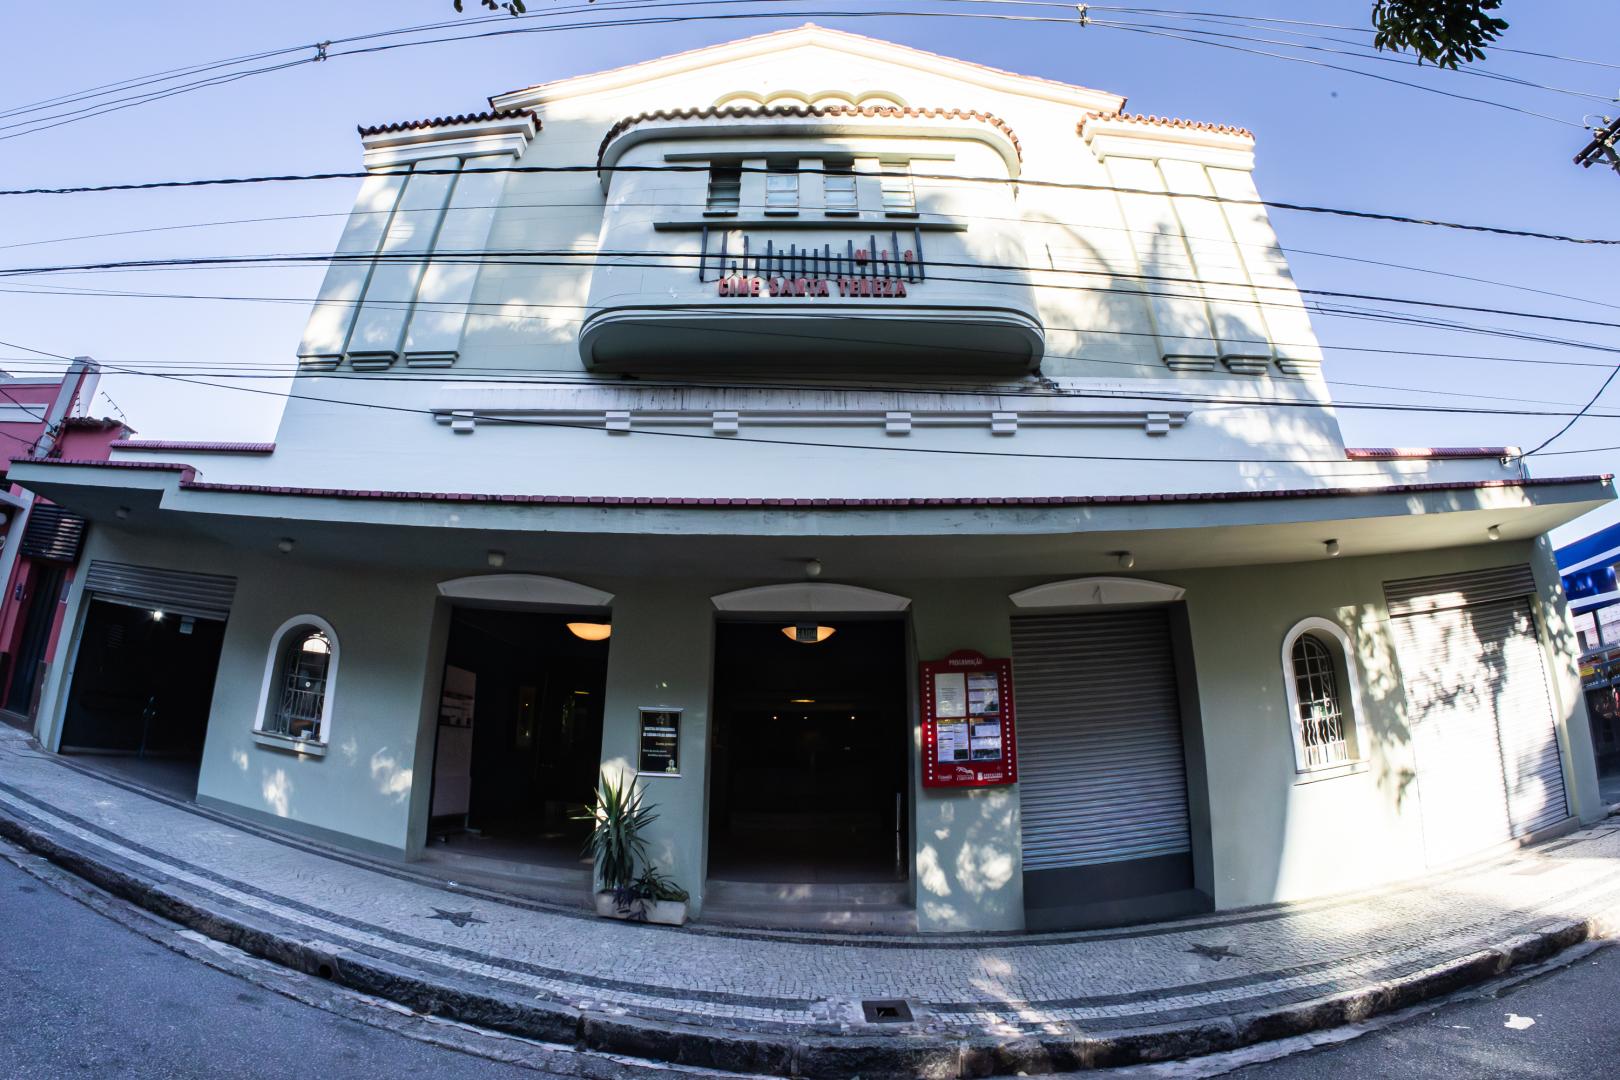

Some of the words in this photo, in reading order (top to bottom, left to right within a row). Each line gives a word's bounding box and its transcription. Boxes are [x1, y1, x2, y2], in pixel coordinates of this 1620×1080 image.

[719, 278, 760, 297] CINE
[769, 278, 829, 297] SANTA
[838, 278, 907, 298] TEREZA
